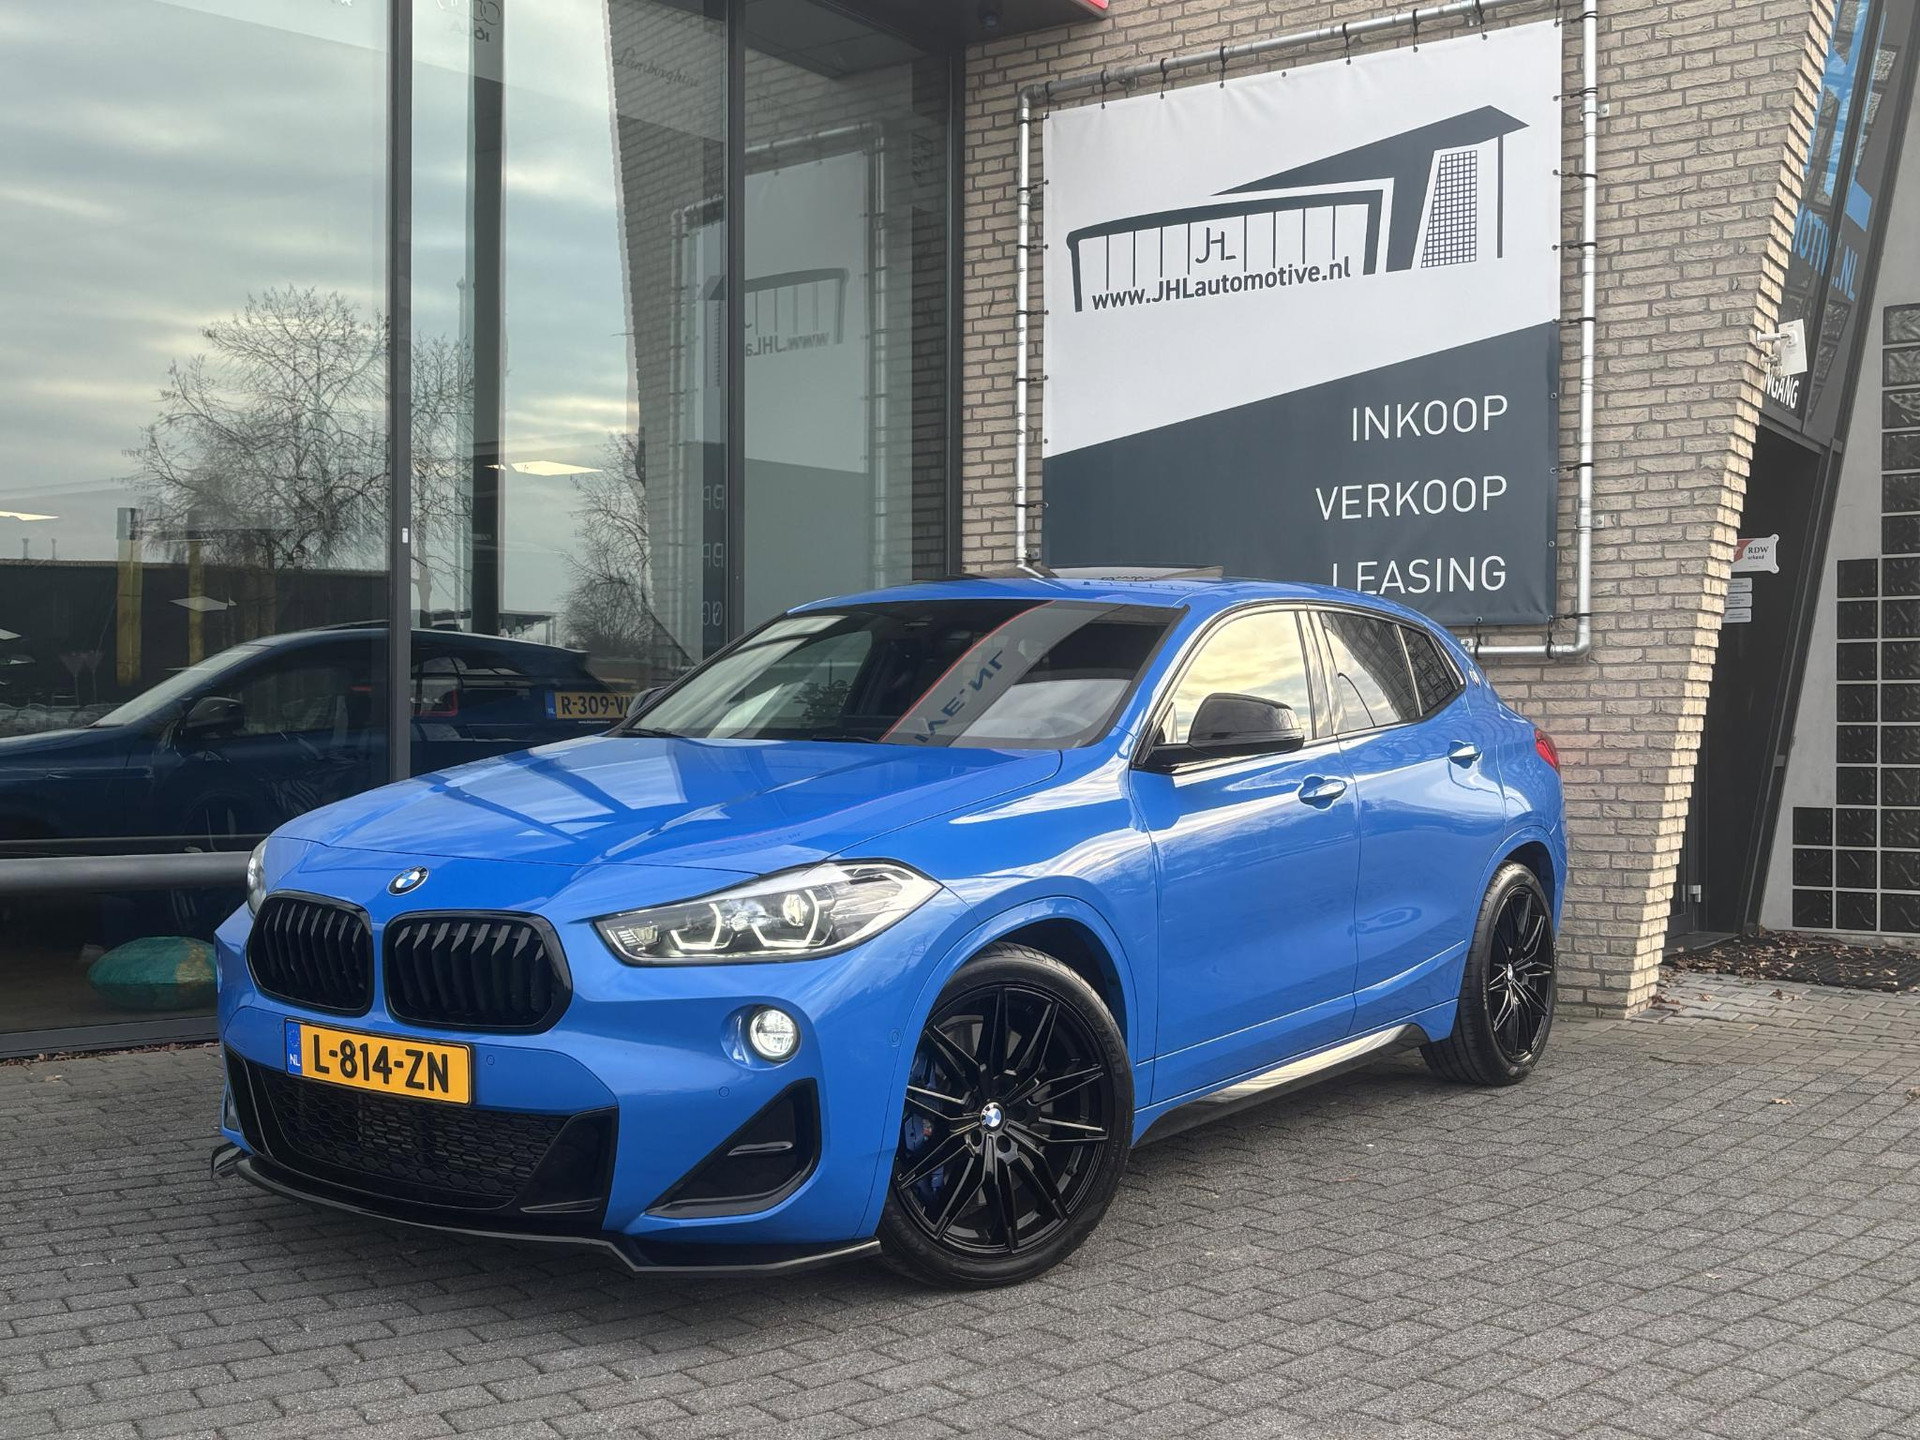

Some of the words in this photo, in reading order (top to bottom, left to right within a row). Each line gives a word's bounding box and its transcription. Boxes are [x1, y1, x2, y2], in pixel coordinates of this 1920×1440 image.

[1092, 256, 1351, 310] www.JHLautomotive.nl
[1352, 394, 1508, 442] INKOOP
[1315, 475, 1508, 521] VERKOOP
[1748, 546, 1769, 554] RDW
[289, 1053, 301, 1067] NL
[313, 1034, 449, 1094] L-814-ZN
